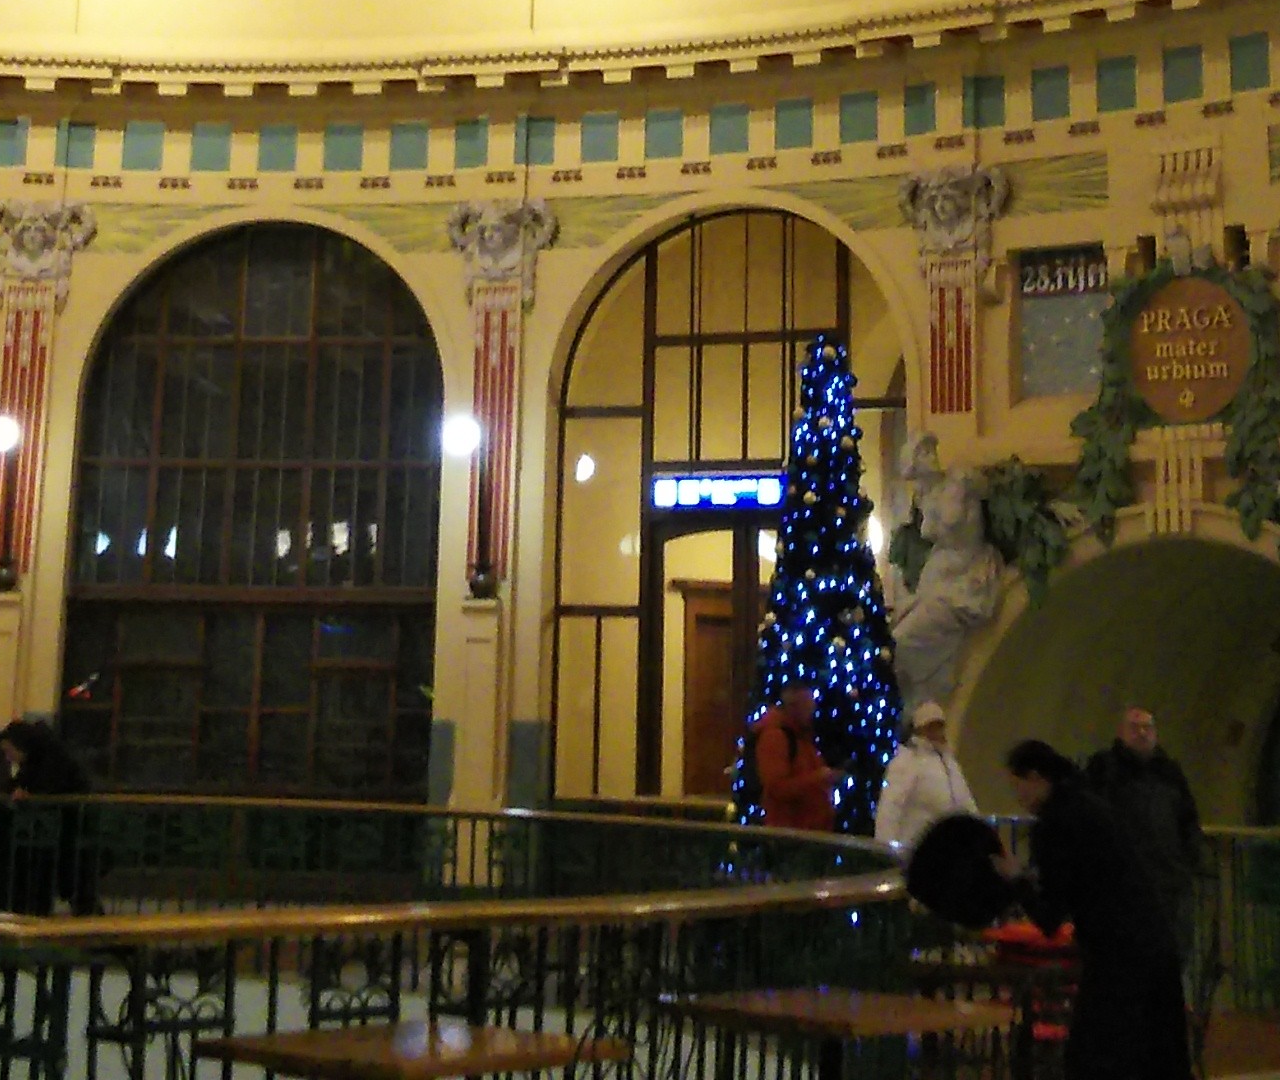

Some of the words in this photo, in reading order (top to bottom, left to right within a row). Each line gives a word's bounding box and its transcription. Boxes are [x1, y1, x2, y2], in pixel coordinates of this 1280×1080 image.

[1140, 304, 1232, 332] PRAGA
[1156, 340, 1218, 358] mater
[1147, 359, 1228, 380] urbium
